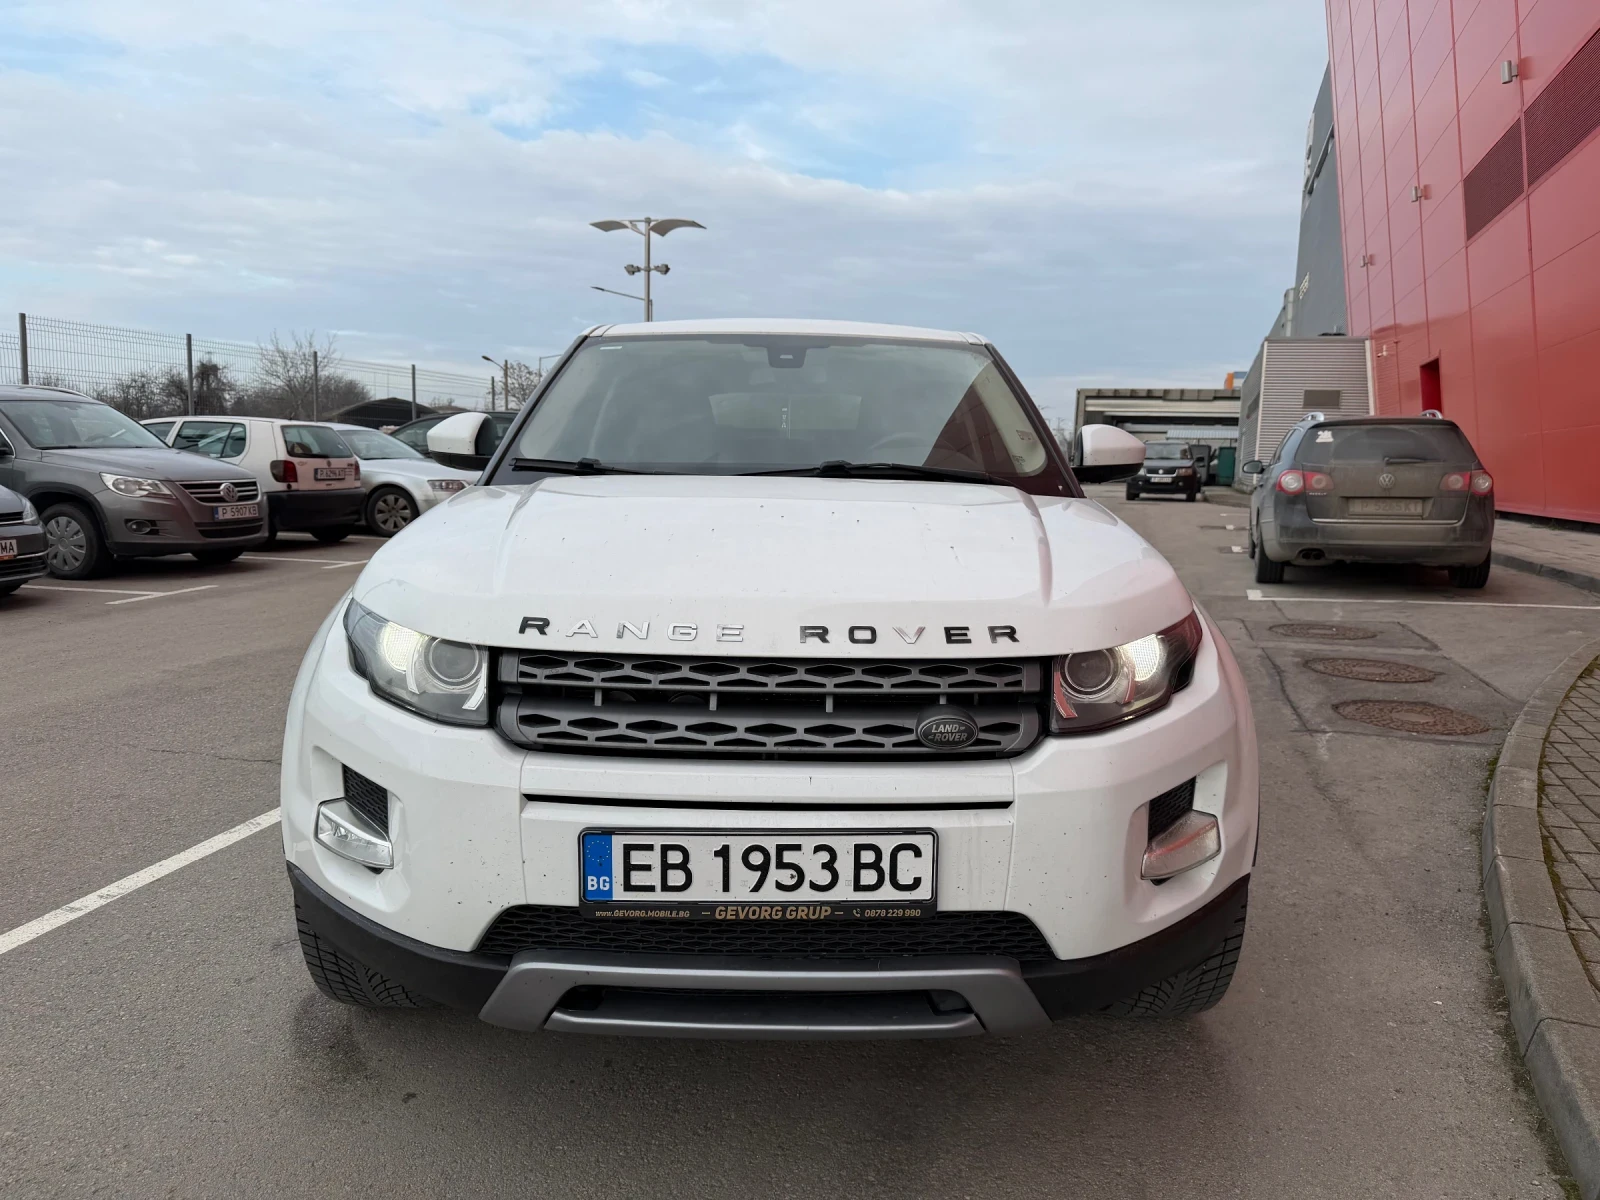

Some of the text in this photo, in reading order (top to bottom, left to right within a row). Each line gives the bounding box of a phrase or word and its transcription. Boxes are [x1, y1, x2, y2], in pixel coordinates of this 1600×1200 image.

[222, 508, 228, 517] P
[518, 616, 1021, 645] RANGE ROVER
[931, 724, 959, 733] LAND
[934, 732, 968, 742] ROVER
[622, 843, 923, 893] EB 1953 BC
[587, 876, 610, 891] BG
[595, 909, 690, 918] www.GEVORG.MOBILE.BG
[715, 906, 832, 920] GEVORG GRUP
[864, 909, 921, 917] 0878 229 990
